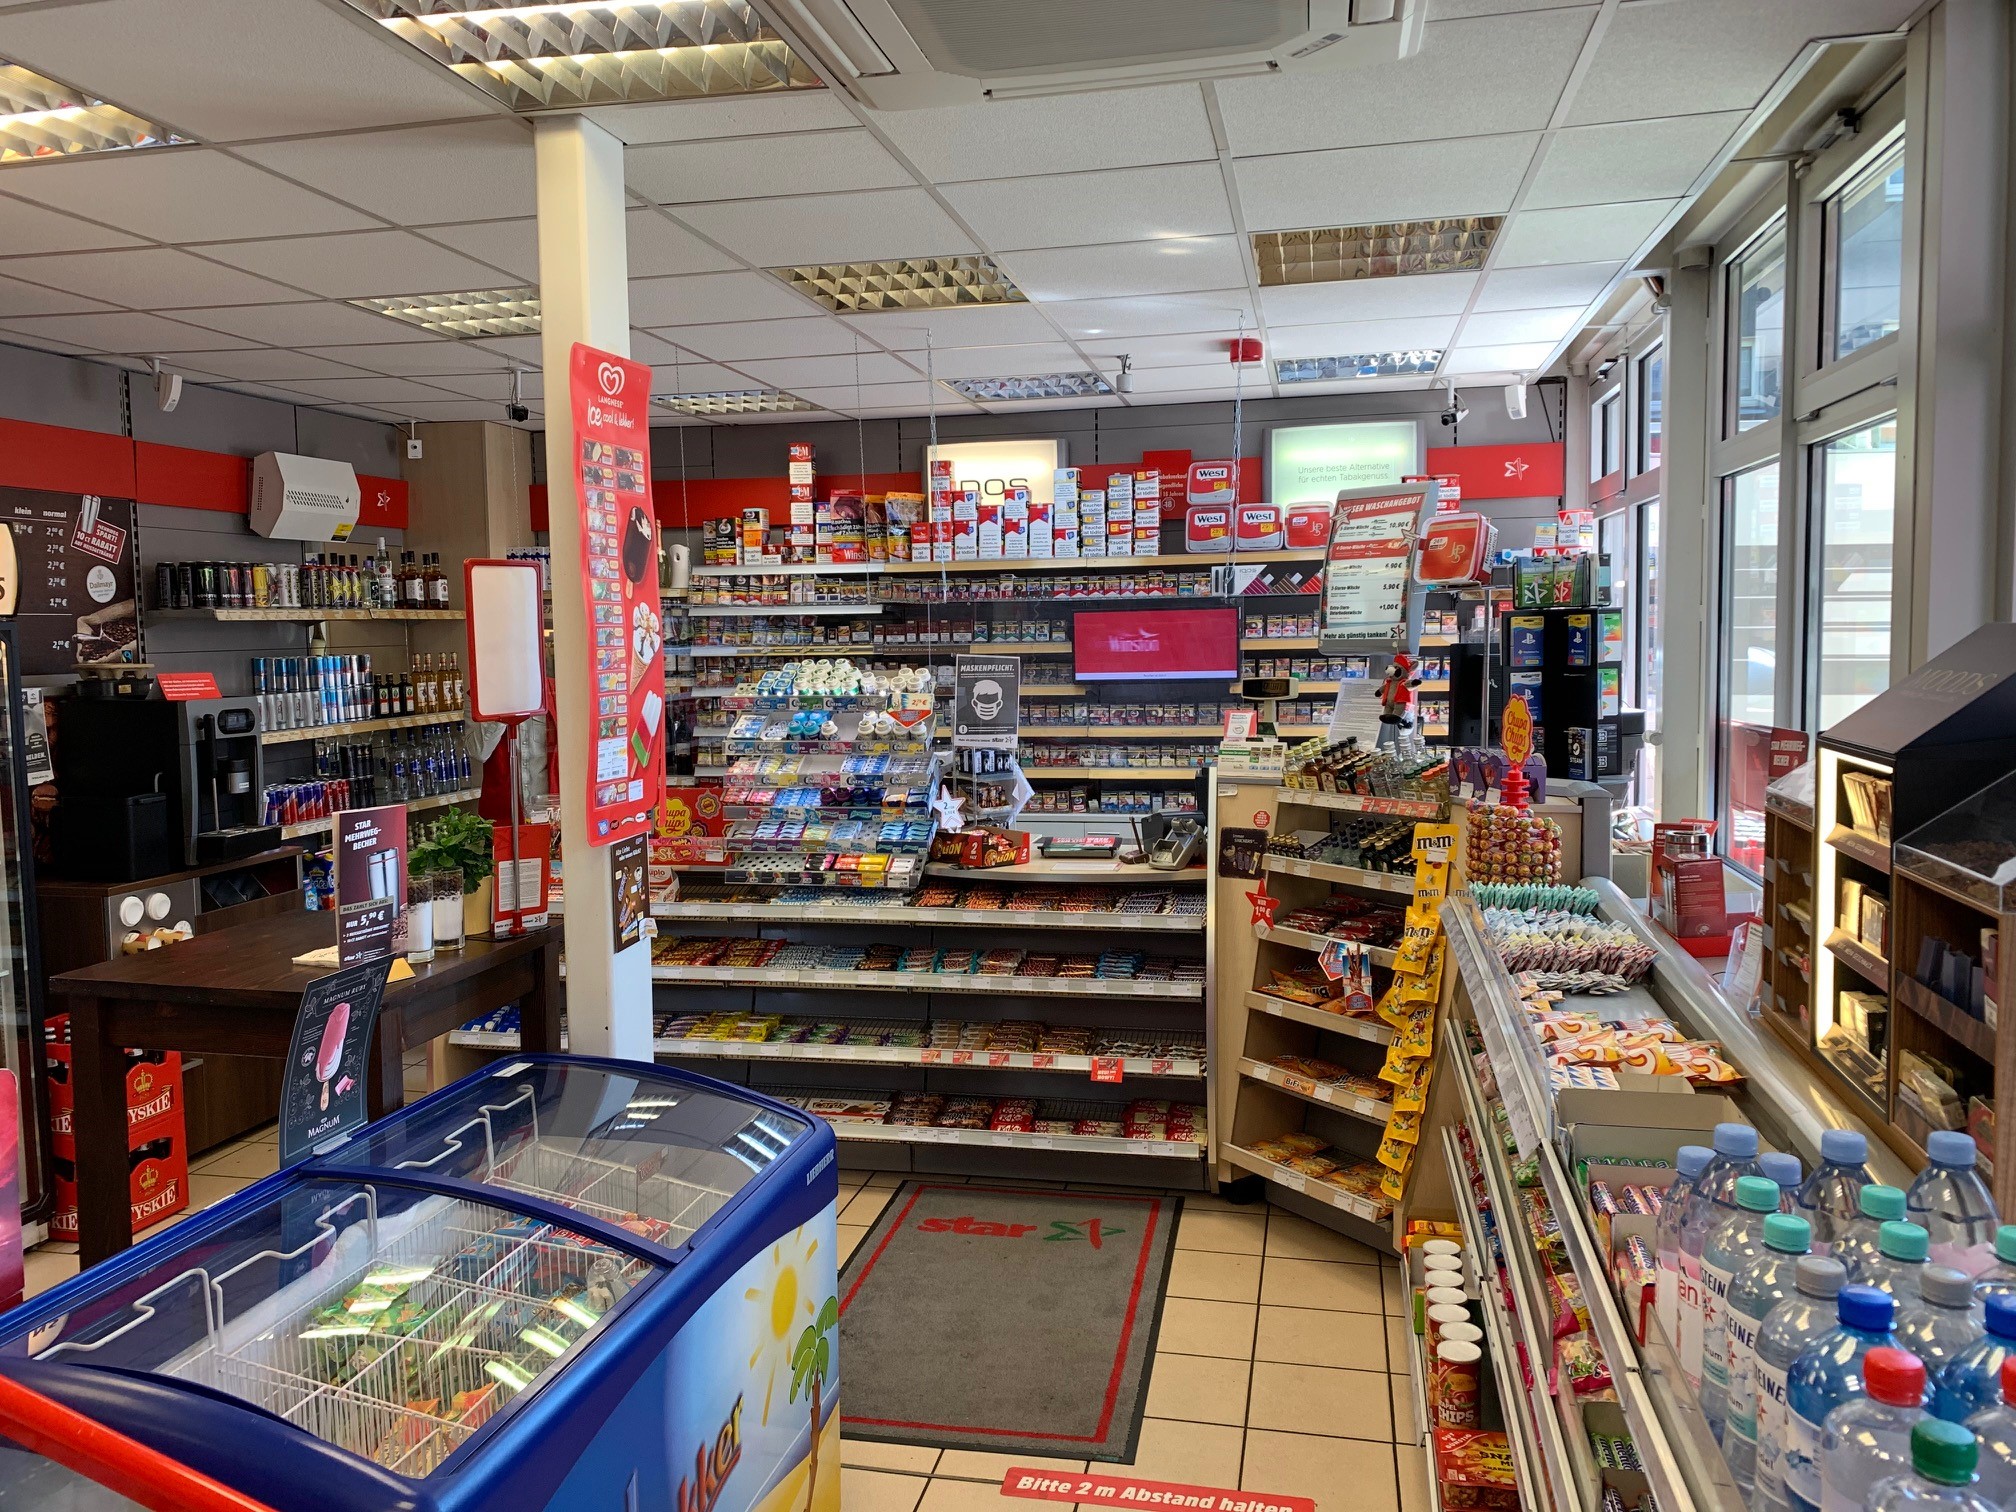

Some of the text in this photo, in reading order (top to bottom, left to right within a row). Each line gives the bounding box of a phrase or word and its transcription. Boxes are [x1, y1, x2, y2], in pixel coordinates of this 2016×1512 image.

[598, 394, 624, 409] LANGNESE
[1199, 469, 1225, 478] West
[1298, 463, 1390, 474] Unsere beste Alternative
[1298, 476, 1309, 484] für
[1311, 474, 1337, 483] echten
[1365, 496, 1422, 511] WASCHANGEBOT
[14, 507, 68, 519] klein normal
[1197, 515, 1223, 523] West
[1245, 512, 1273, 521] West
[76, 531, 85, 541] 10
[91, 536, 118, 554] RABATT
[95, 529, 118, 544] SPART!
[89, 580, 114, 590] Dallmayr
[1346, 632, 1367, 640] günstig
[1367, 631, 1388, 639] tanken!
[960, 664, 1015, 672] MASKENPFLICHT.
[1507, 711, 1528, 730] Chupa
[1506, 726, 1527, 747] Chups
[354, 820, 372, 831] STAR
[345, 828, 382, 843] MEHRWEG-
[353, 837, 377, 851] BECHER
[941, 841, 978, 856] LION 2
[997, 850, 1017, 863] LION
[649, 868, 666, 878] uplo
[346, 920, 358, 929] NUR
[323, 984, 368, 1005] MAGNUM RUBY
[128, 1088, 172, 1124] YSKIE
[308, 1114, 341, 1139] MAGNUM
[806, 1149, 835, 1186] LIEBHERR
[917, 1216, 1038, 1238] star
[1439, 1402, 1458, 1411] APEL
[1441, 1432, 1455, 1441] GUT
[1445, 1433, 1472, 1450] GÜNSTIG
[1016, 1475, 1071, 1494] Bitte
[1074, 1481, 1093, 1495] 2
[1094, 1485, 1115, 1498] m
[1119, 1487, 1219, 1511] Abstand
